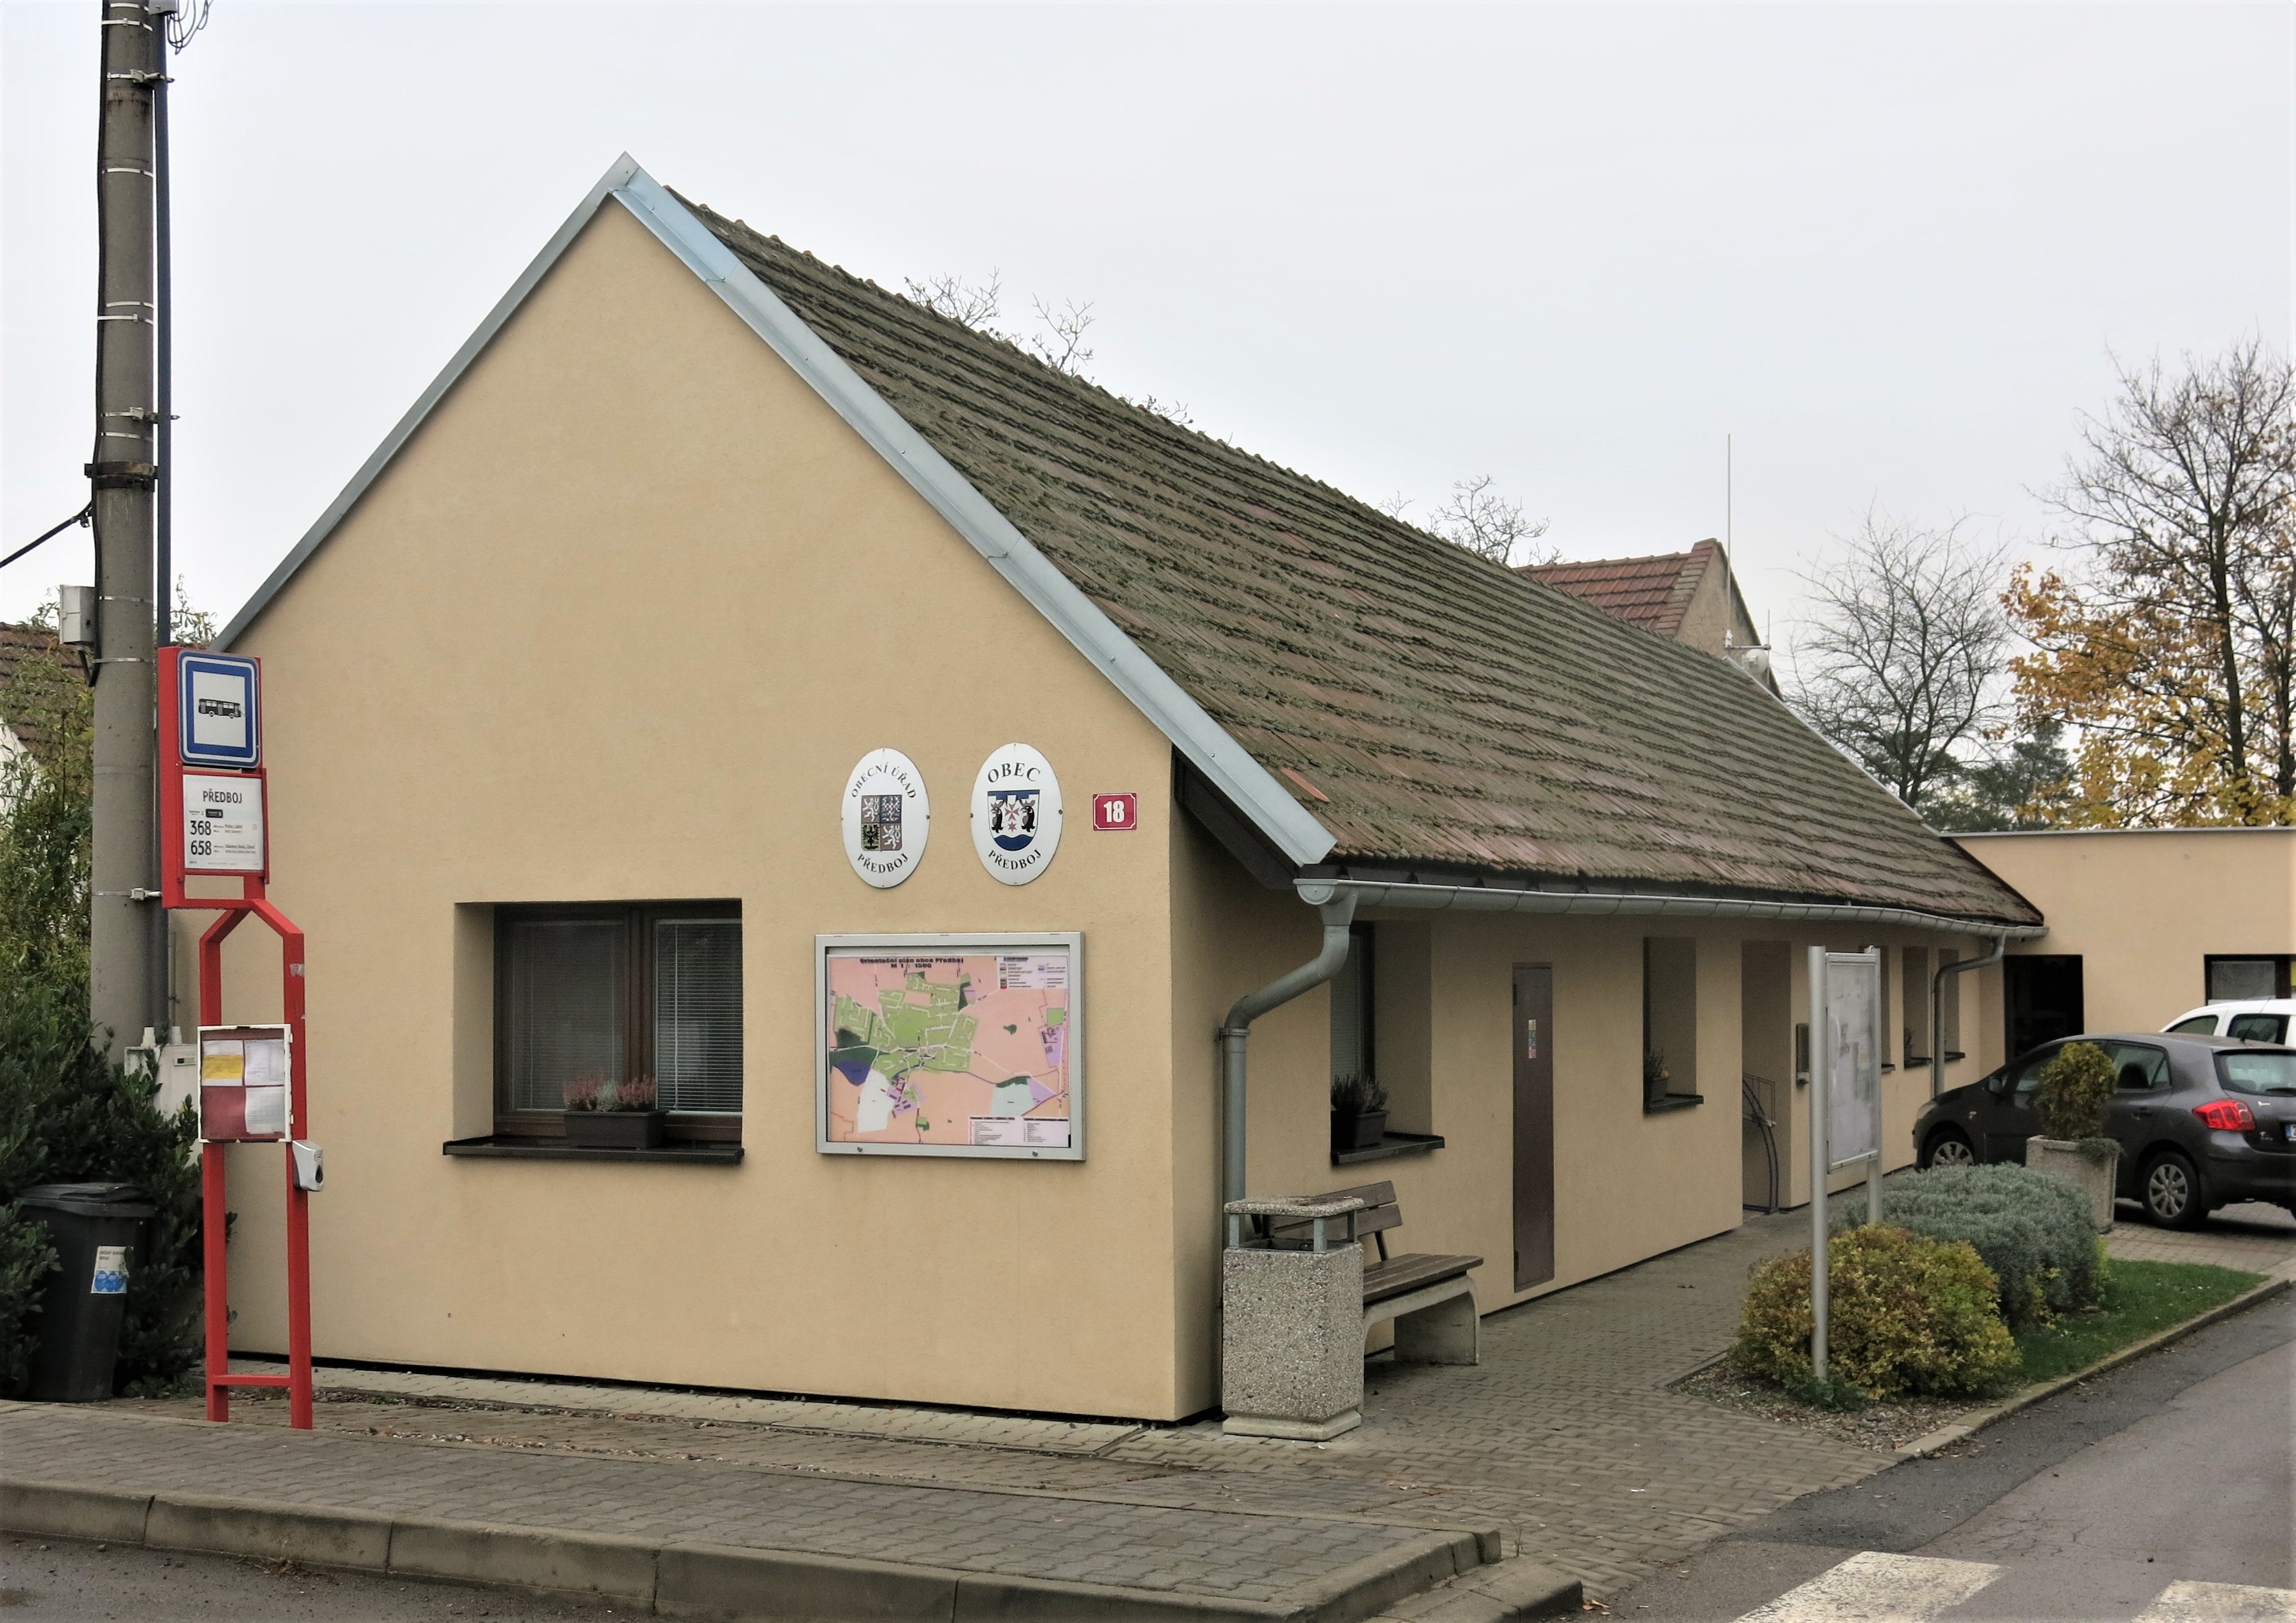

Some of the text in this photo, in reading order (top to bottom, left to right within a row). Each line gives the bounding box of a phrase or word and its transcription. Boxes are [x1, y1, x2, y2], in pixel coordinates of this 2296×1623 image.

[851, 761, 916, 798] OBECNÍ ÚŘAD
[988, 762, 1041, 783] OBEC
[203, 788, 243, 804] PŘEDBOJ
[1103, 800, 1125, 823] 18
[190, 820, 212, 835] 368
[191, 840, 212, 855] 658
[857, 853, 908, 874] PŘEDBOJ
[988, 849, 1041, 870] PŘEDBOJ
